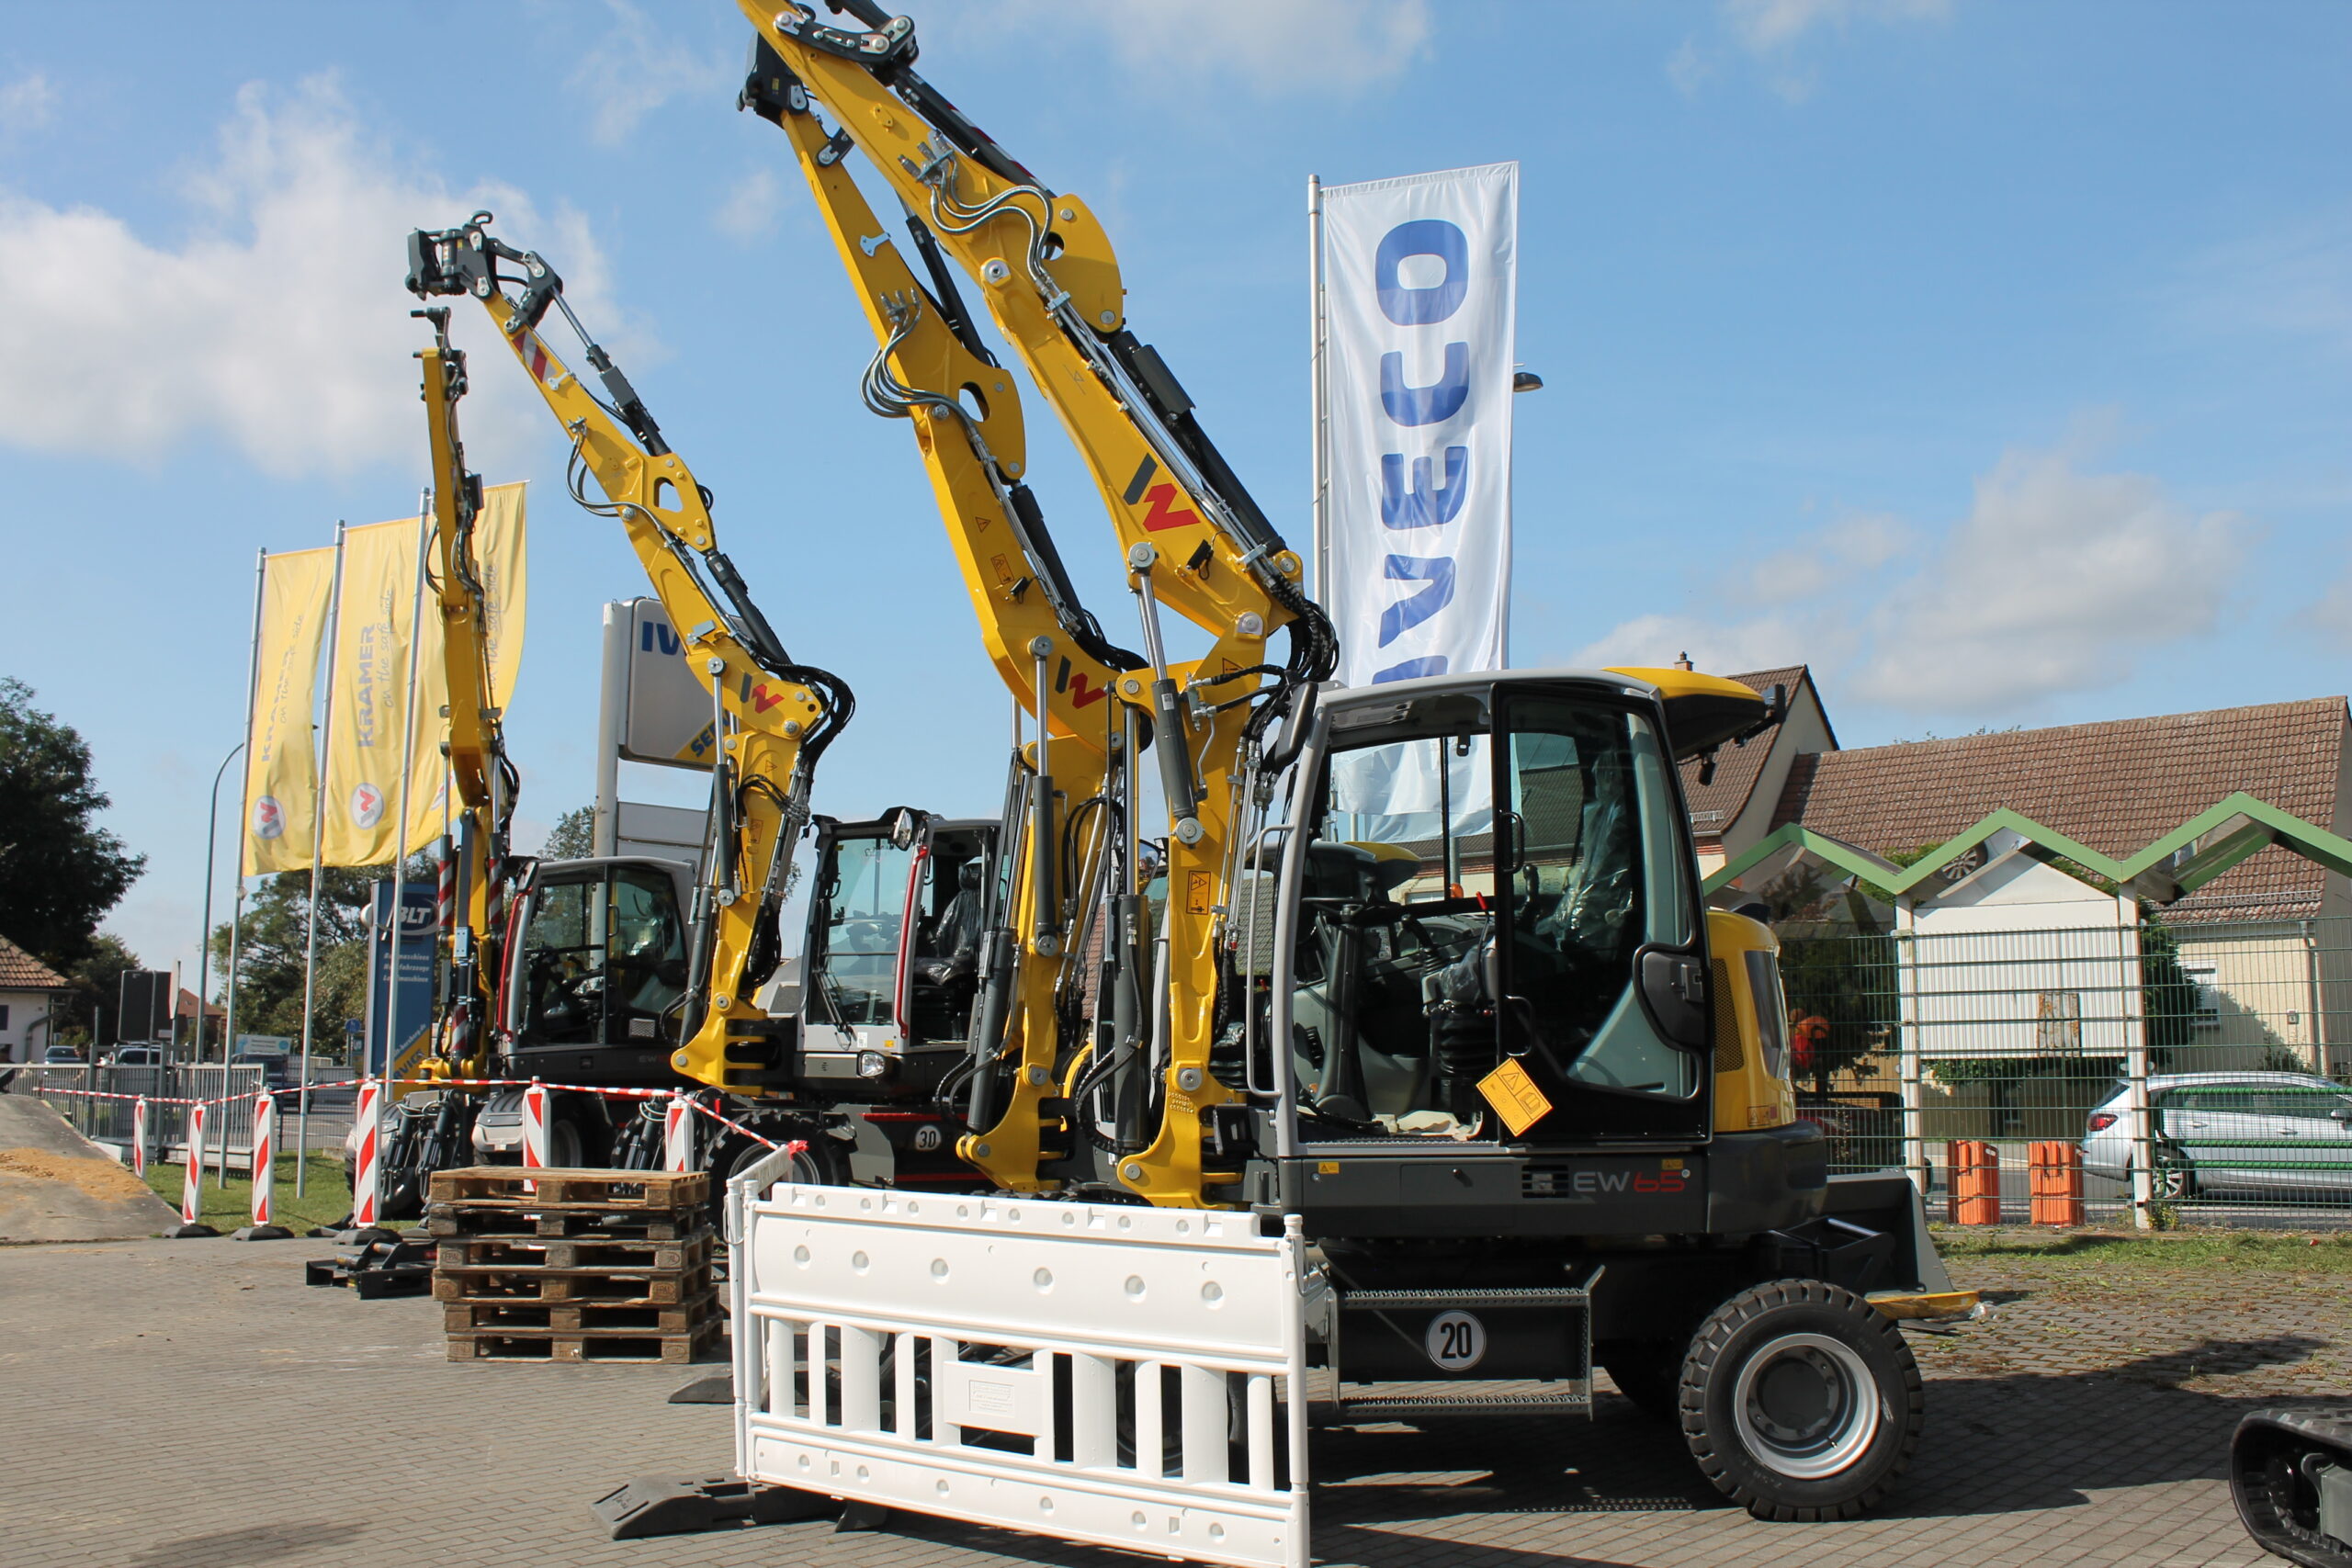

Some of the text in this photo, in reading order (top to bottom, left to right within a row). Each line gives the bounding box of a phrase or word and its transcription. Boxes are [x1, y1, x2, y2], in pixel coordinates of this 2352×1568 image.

[1372, 219, 1470, 685] IVECO
[482, 564, 498, 593] side
[484, 601, 504, 632] safe
[377, 587, 396, 708] on the safe side
[357, 624, 376, 748] KRAMER
[399, 906, 431, 924] BLT
[919, 1130, 937, 1148] 30
[1573, 1171, 1686, 1192] EW65
[1440, 1321, 1473, 1359] 20
